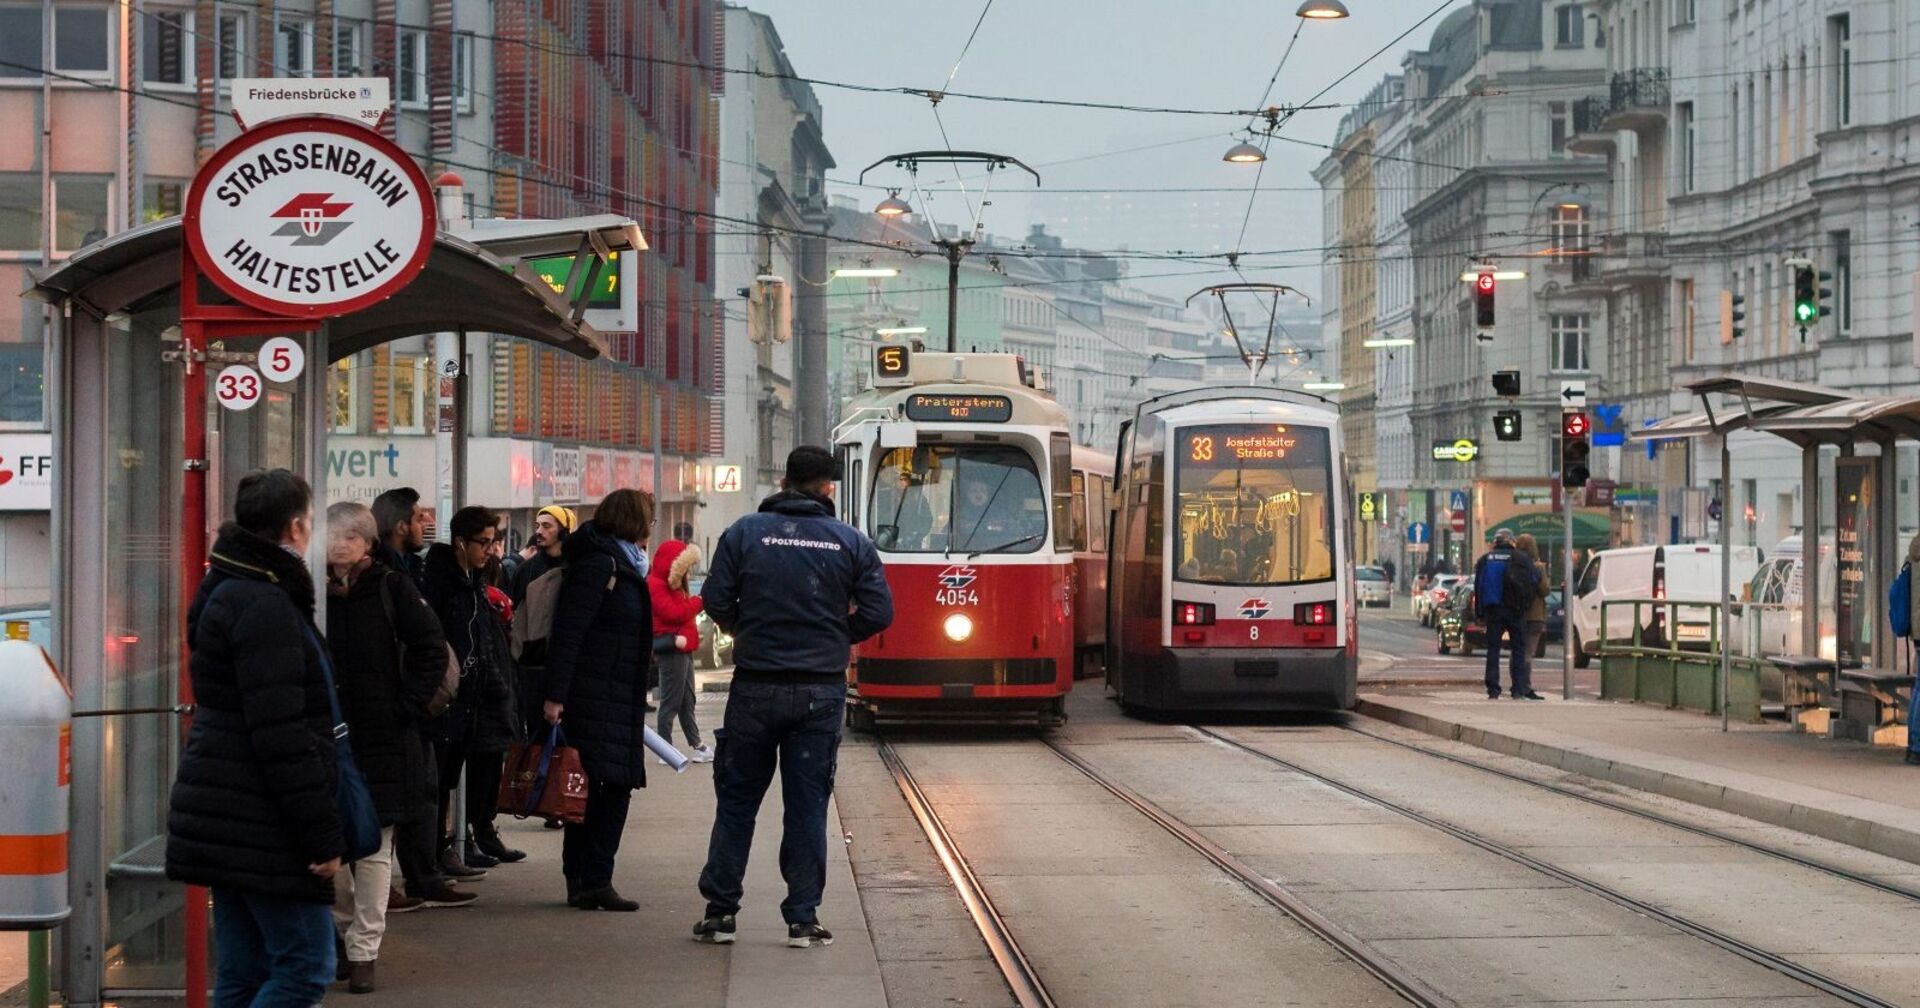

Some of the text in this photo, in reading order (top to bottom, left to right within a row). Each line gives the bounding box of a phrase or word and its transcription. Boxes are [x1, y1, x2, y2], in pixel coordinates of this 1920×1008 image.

[249, 88, 356, 100] Friedensbrücke
[360, 109, 379, 118] 385
[216, 143, 409, 208] STRASSENBAHN
[224, 238, 400, 294] HALTESTELLE
[608, 275, 617, 292] 7
[272, 347, 291, 372] 5
[884, 351, 901, 371] 5
[219, 375, 258, 400] 33
[916, 396, 1005, 408] Praterstern
[1192, 437, 1212, 460] 33
[1226, 437, 1296, 448] Josefstädter
[1236, 448, 1274, 458] Straße
[771, 537, 841, 551] POLYGONVATRO
[936, 589, 979, 606] 4054
[1250, 625, 1259, 640] 8
